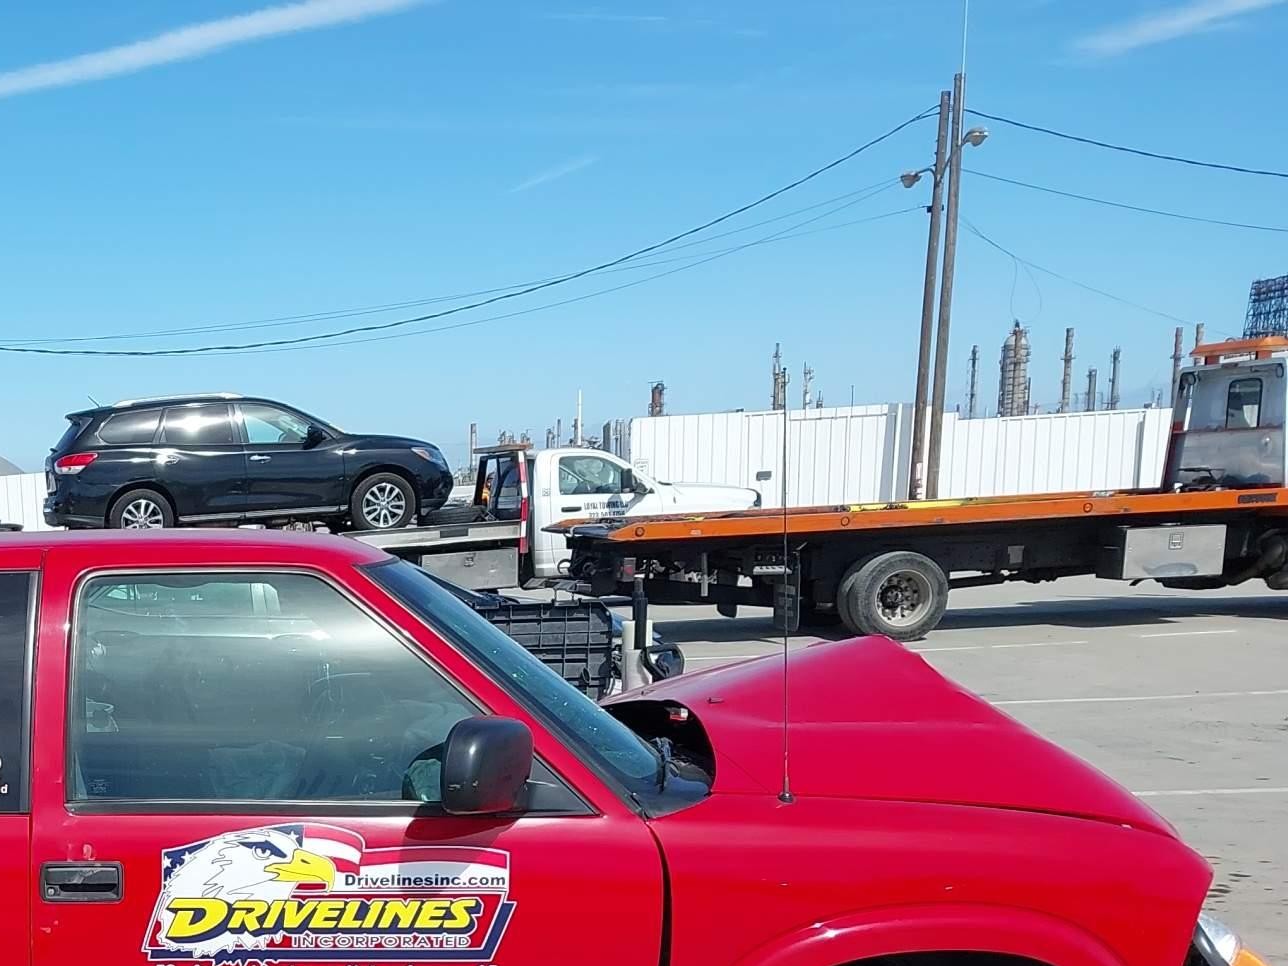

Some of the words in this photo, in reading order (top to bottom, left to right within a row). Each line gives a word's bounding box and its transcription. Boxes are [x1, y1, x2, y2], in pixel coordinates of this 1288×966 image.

[344, 873, 506, 887] Drivelinesinc.com
[165, 897, 481, 943] DRIVELINES
[291, 934, 471, 948] INCORPORATED
